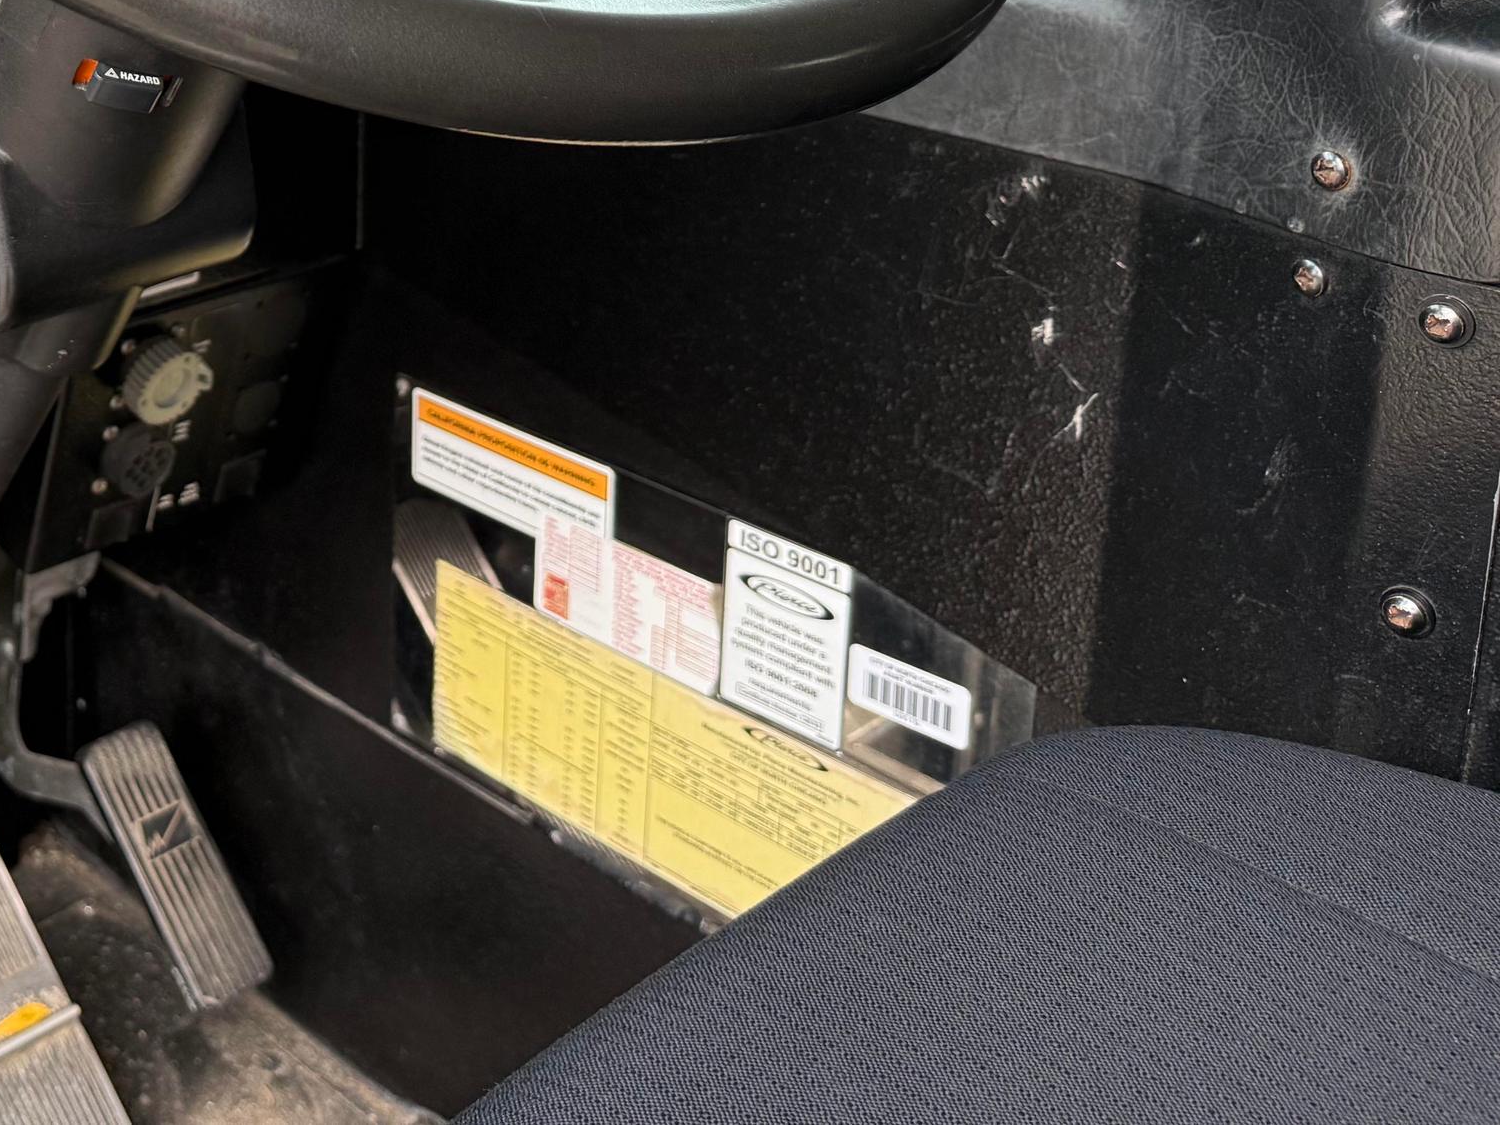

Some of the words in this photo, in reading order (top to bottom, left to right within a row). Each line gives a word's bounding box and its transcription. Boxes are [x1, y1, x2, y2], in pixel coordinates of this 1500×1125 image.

[120, 71, 161, 85] HAZARD
[740, 529, 780, 560] ISO
[788, 549, 840, 585] 9001
[754, 579, 819, 615] Pierce
